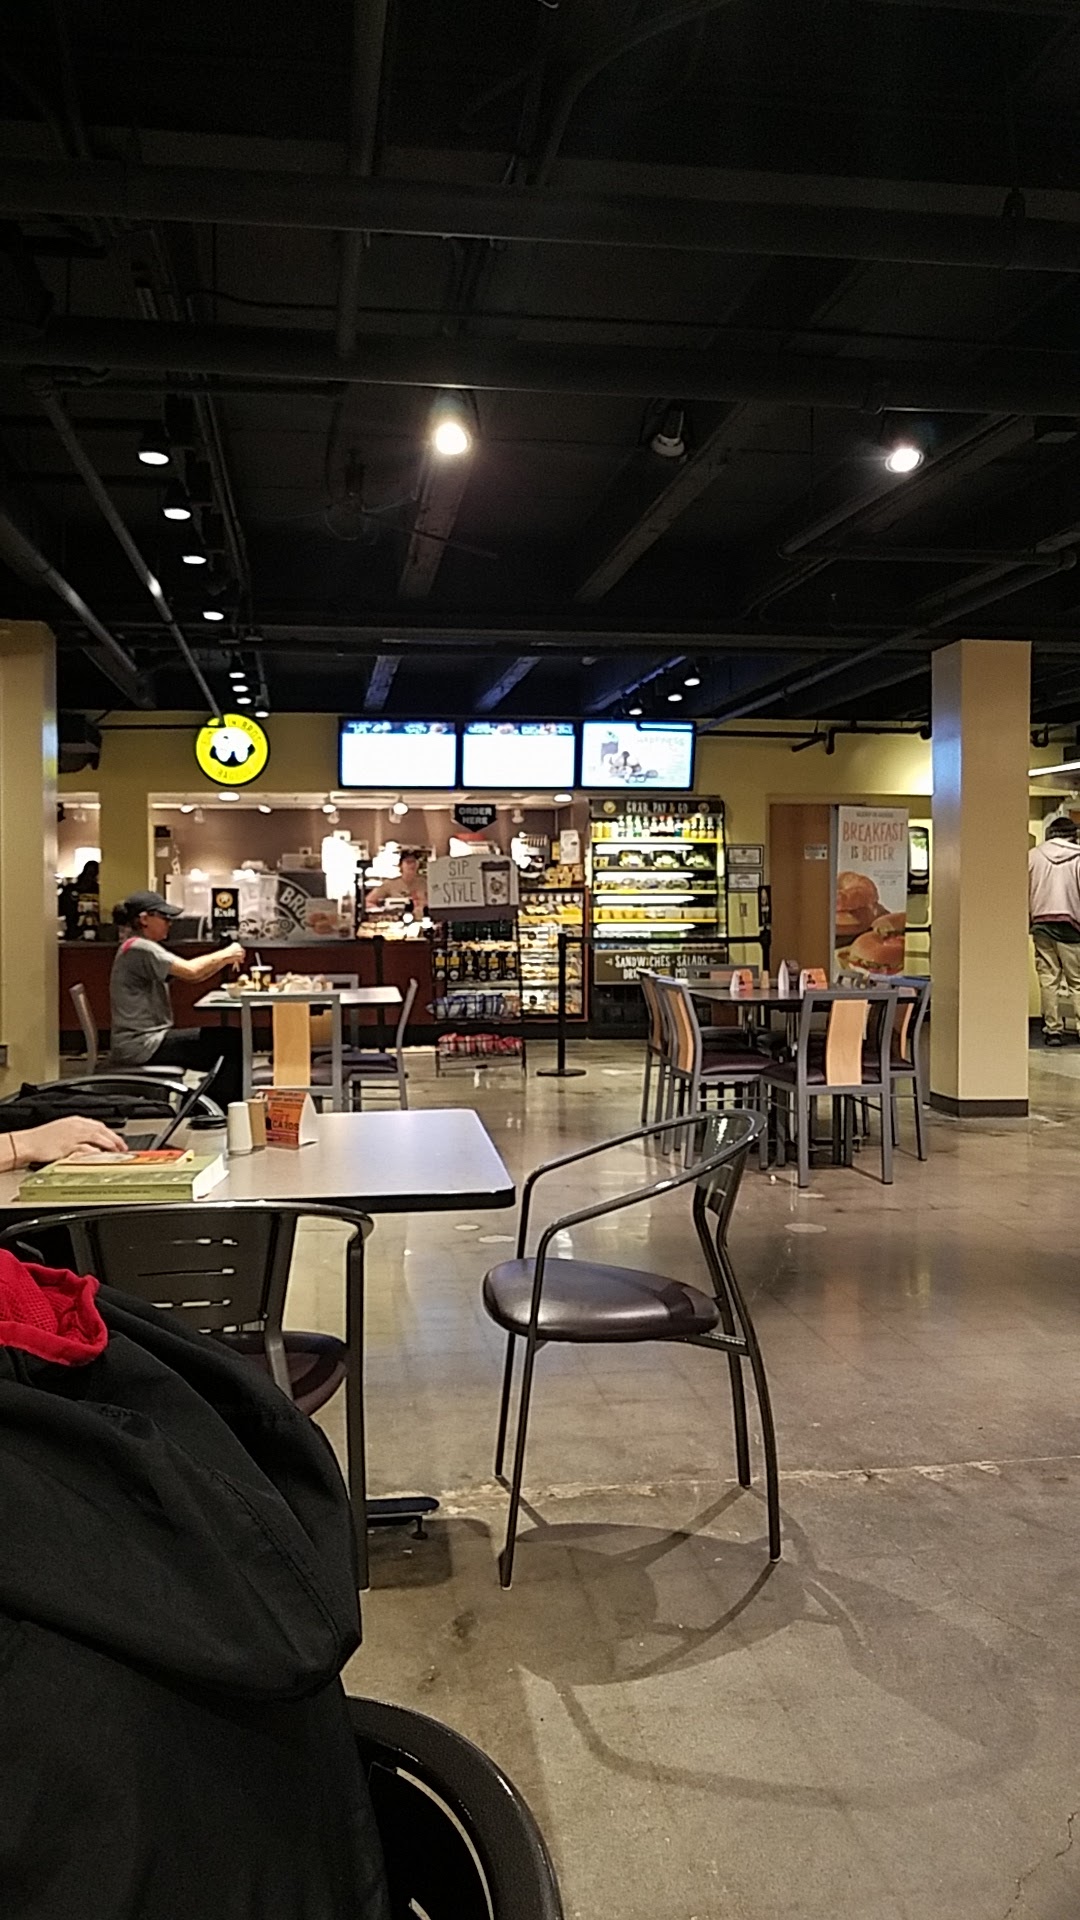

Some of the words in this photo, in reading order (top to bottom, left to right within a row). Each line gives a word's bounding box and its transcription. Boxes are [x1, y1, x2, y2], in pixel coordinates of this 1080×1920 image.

[458, 807, 492, 815] ORDER
[652, 802, 667, 813] PAY
[677, 803, 688, 813] GO
[462, 816, 488, 825] HERE
[842, 821, 905, 842] BREAKFAST
[851, 845, 859, 859] IS
[862, 844, 895, 861] BETTER
[449, 860, 470, 876] SIP
[443, 881, 478, 903] STYLE
[676, 955, 708, 967] SALADS
